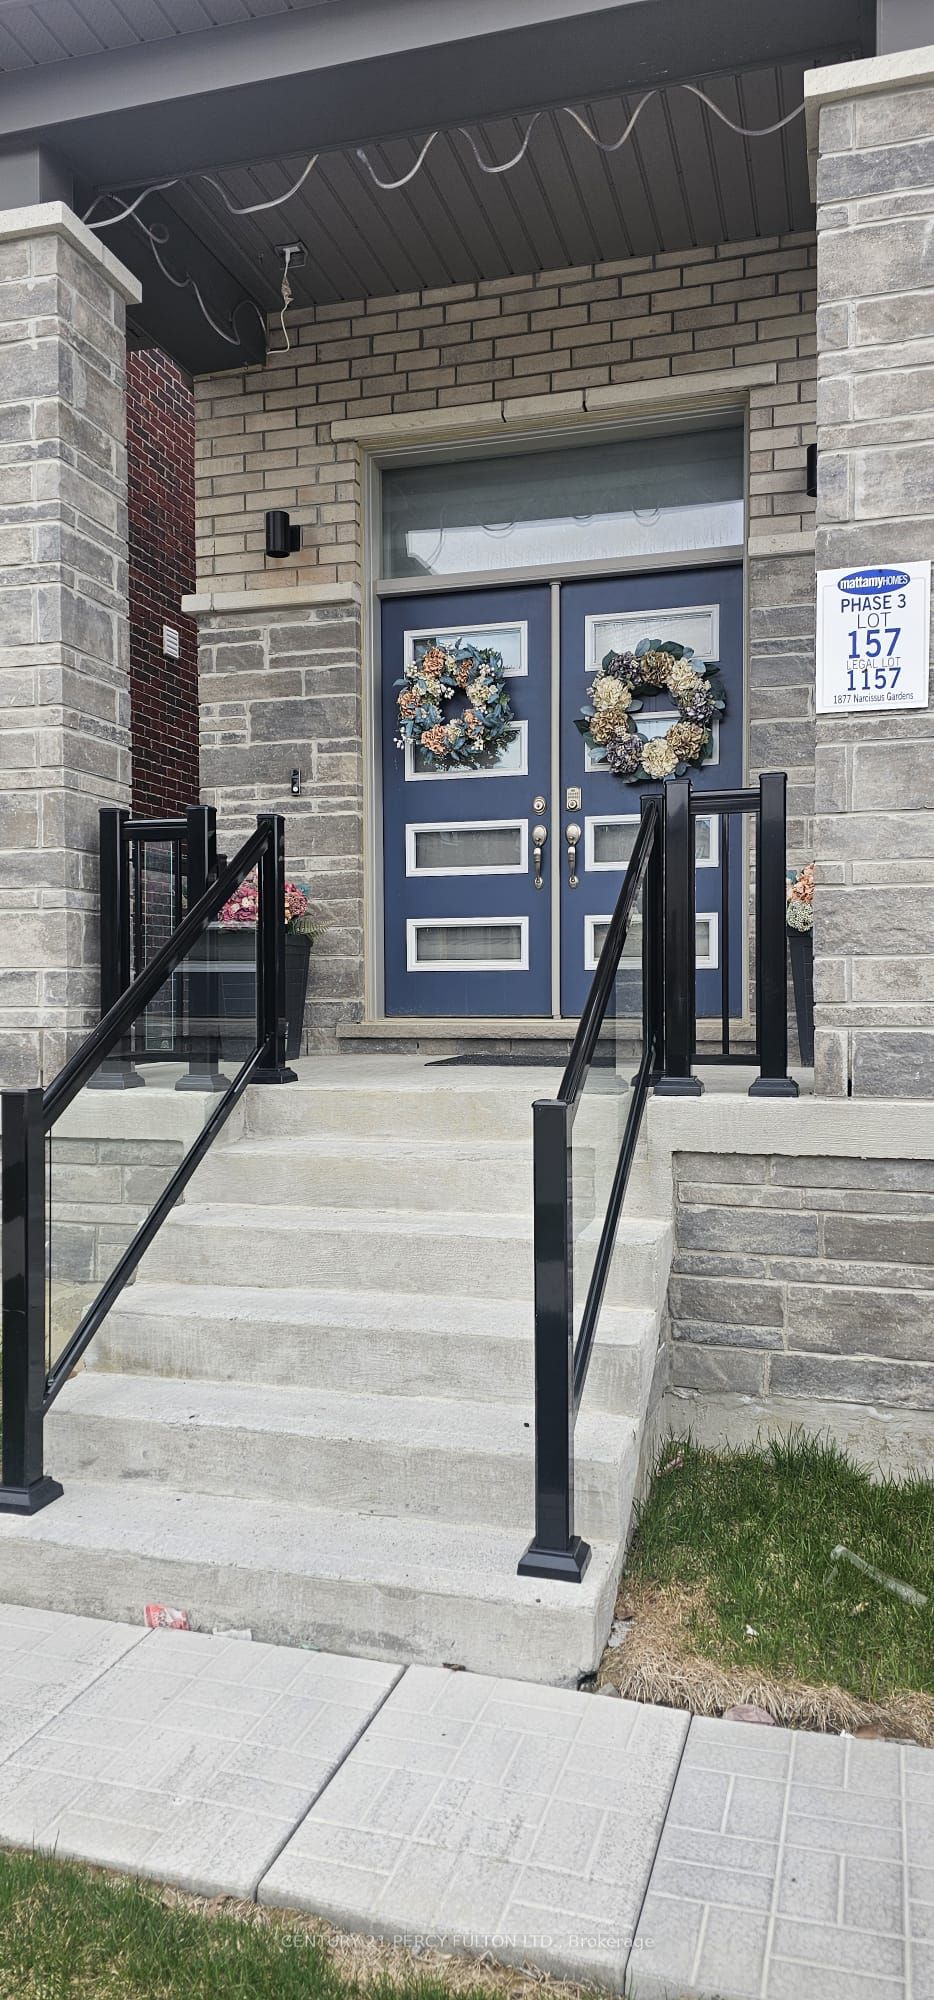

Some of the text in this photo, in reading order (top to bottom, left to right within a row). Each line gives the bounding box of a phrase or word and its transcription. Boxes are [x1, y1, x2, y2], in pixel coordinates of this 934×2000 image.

[840, 574, 908, 590] mattamyHOMES
[841, 593, 906, 613] PHASE 3
[858, 612, 892, 629] LOT
[848, 627, 901, 659] 157
[846, 656, 902, 670] LEGAL LOT
[847, 667, 901, 691] 1157
[833, 691, 914, 705] 1877 Narcissus Gardens
